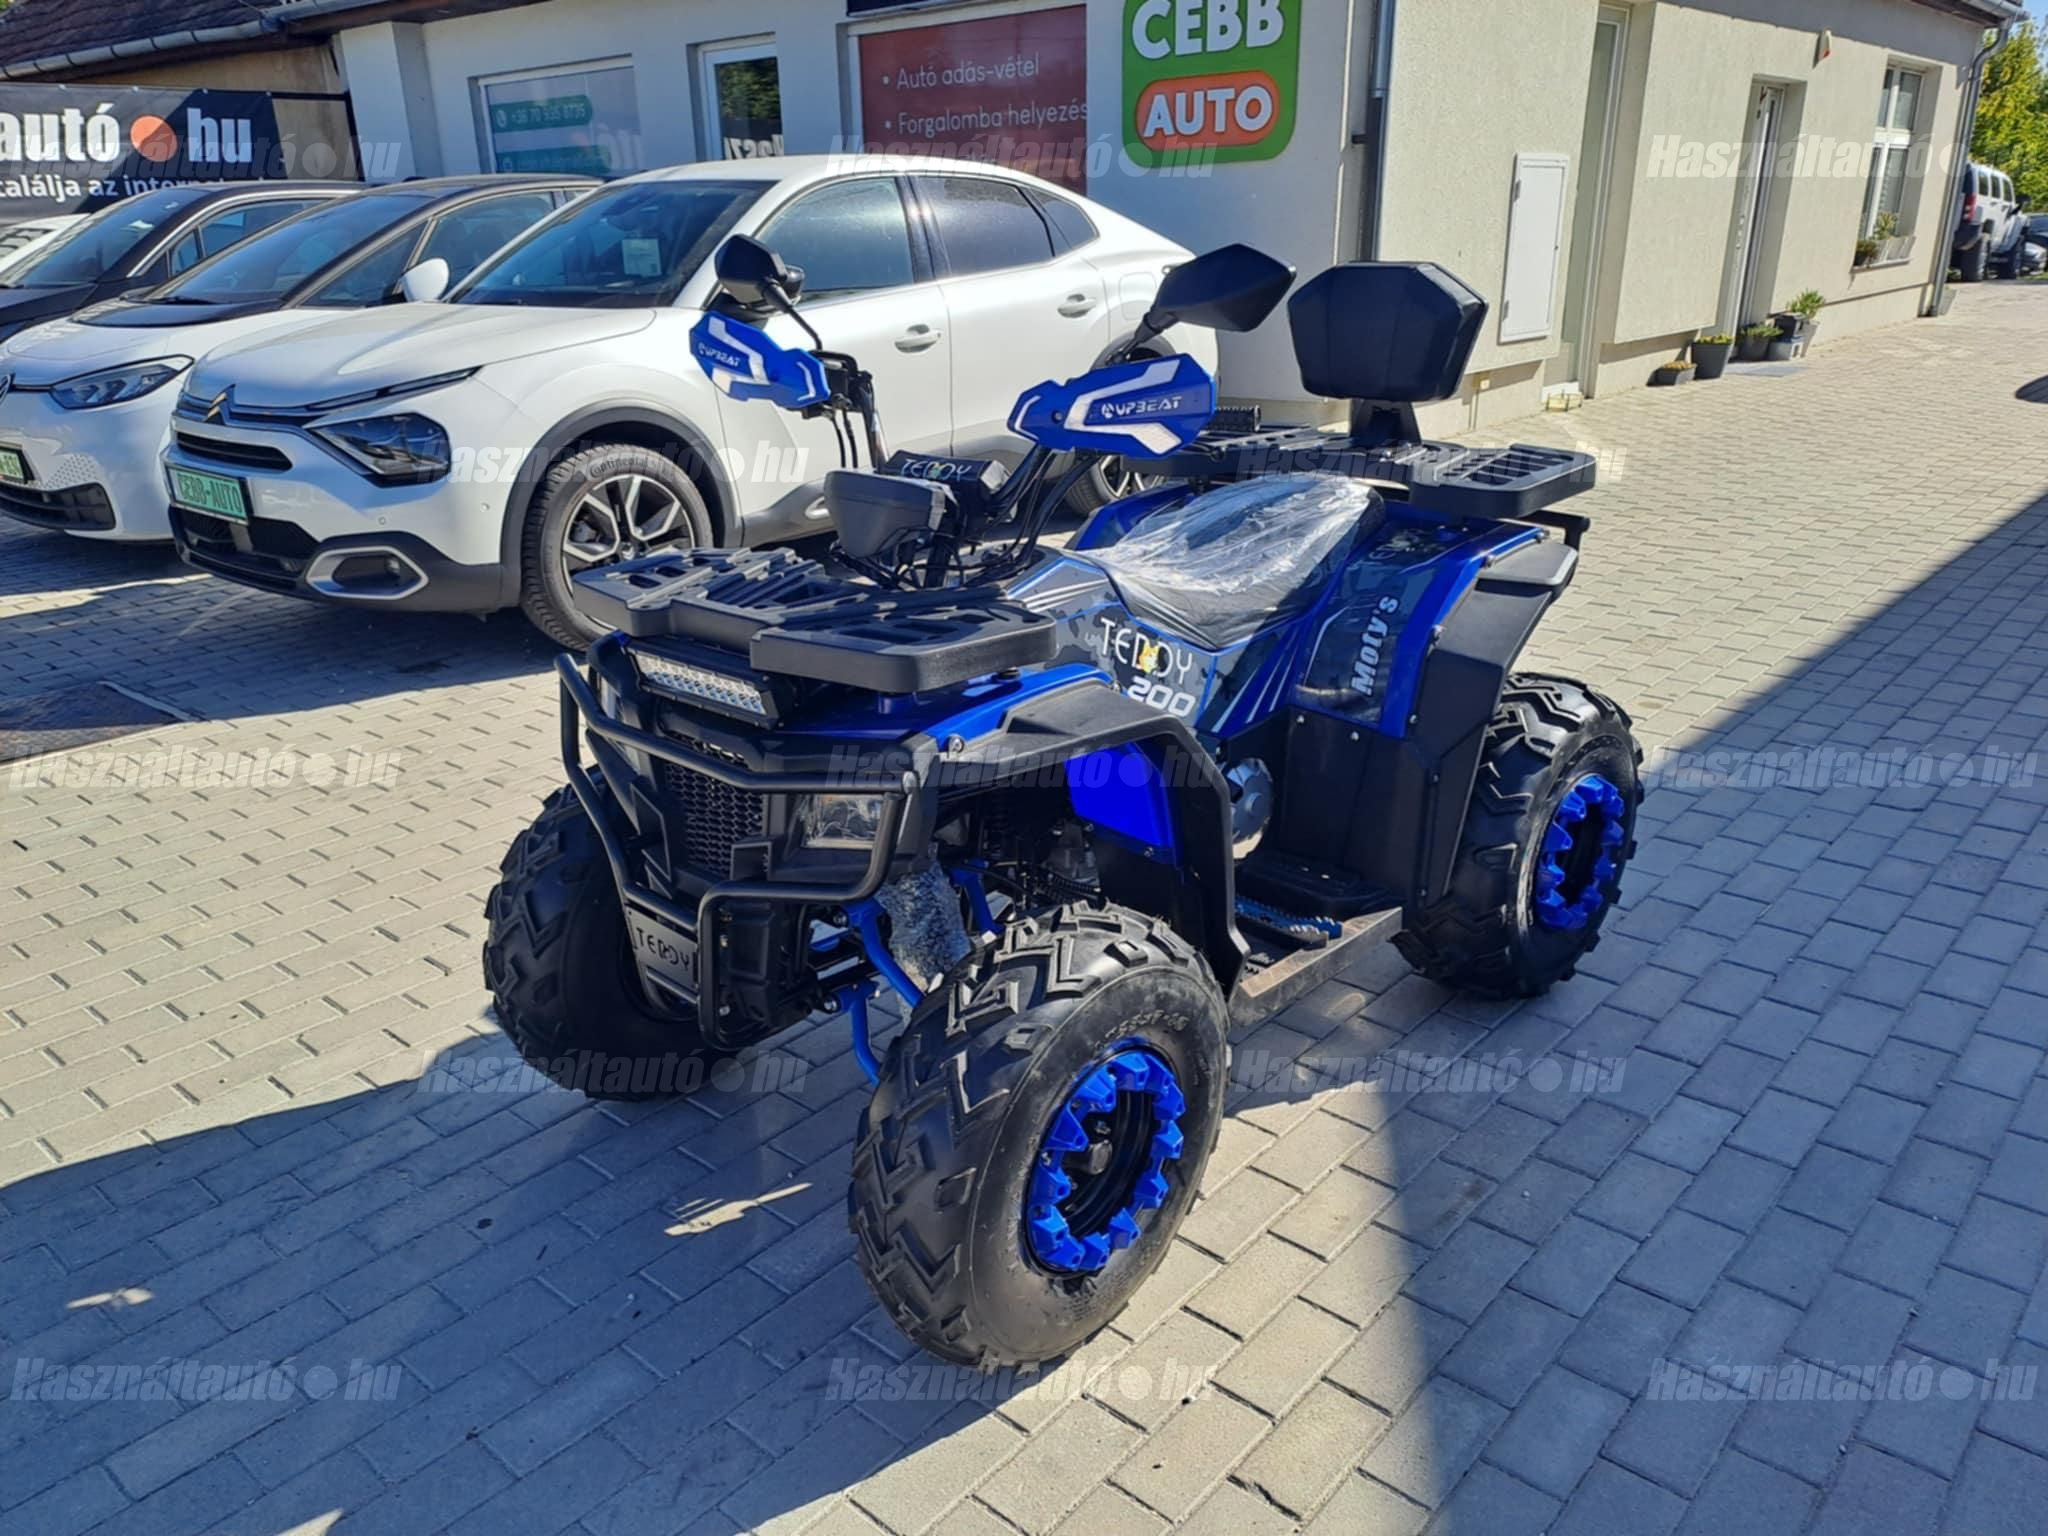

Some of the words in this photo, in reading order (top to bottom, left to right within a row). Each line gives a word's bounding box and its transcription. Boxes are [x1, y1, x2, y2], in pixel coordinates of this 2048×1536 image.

[1132, 0, 1284, 59] CEBB
[897, 65, 937, 89] Autó
[942, 52, 1040, 84] adás-vétel
[899, 105, 1002, 138] Forgalomba
[1008, 98, 1088, 130] helyezés
[1143, 85, 1273, 138] AUTO
[186, 107, 252, 163] hu
[88, 178, 119, 197] az
[1115, 396, 1182, 416] UPBEAT
[1100, 617, 1192, 684] TEDDY
[1351, 596, 1398, 696] Moty's
[1127, 676, 1196, 707] 200
